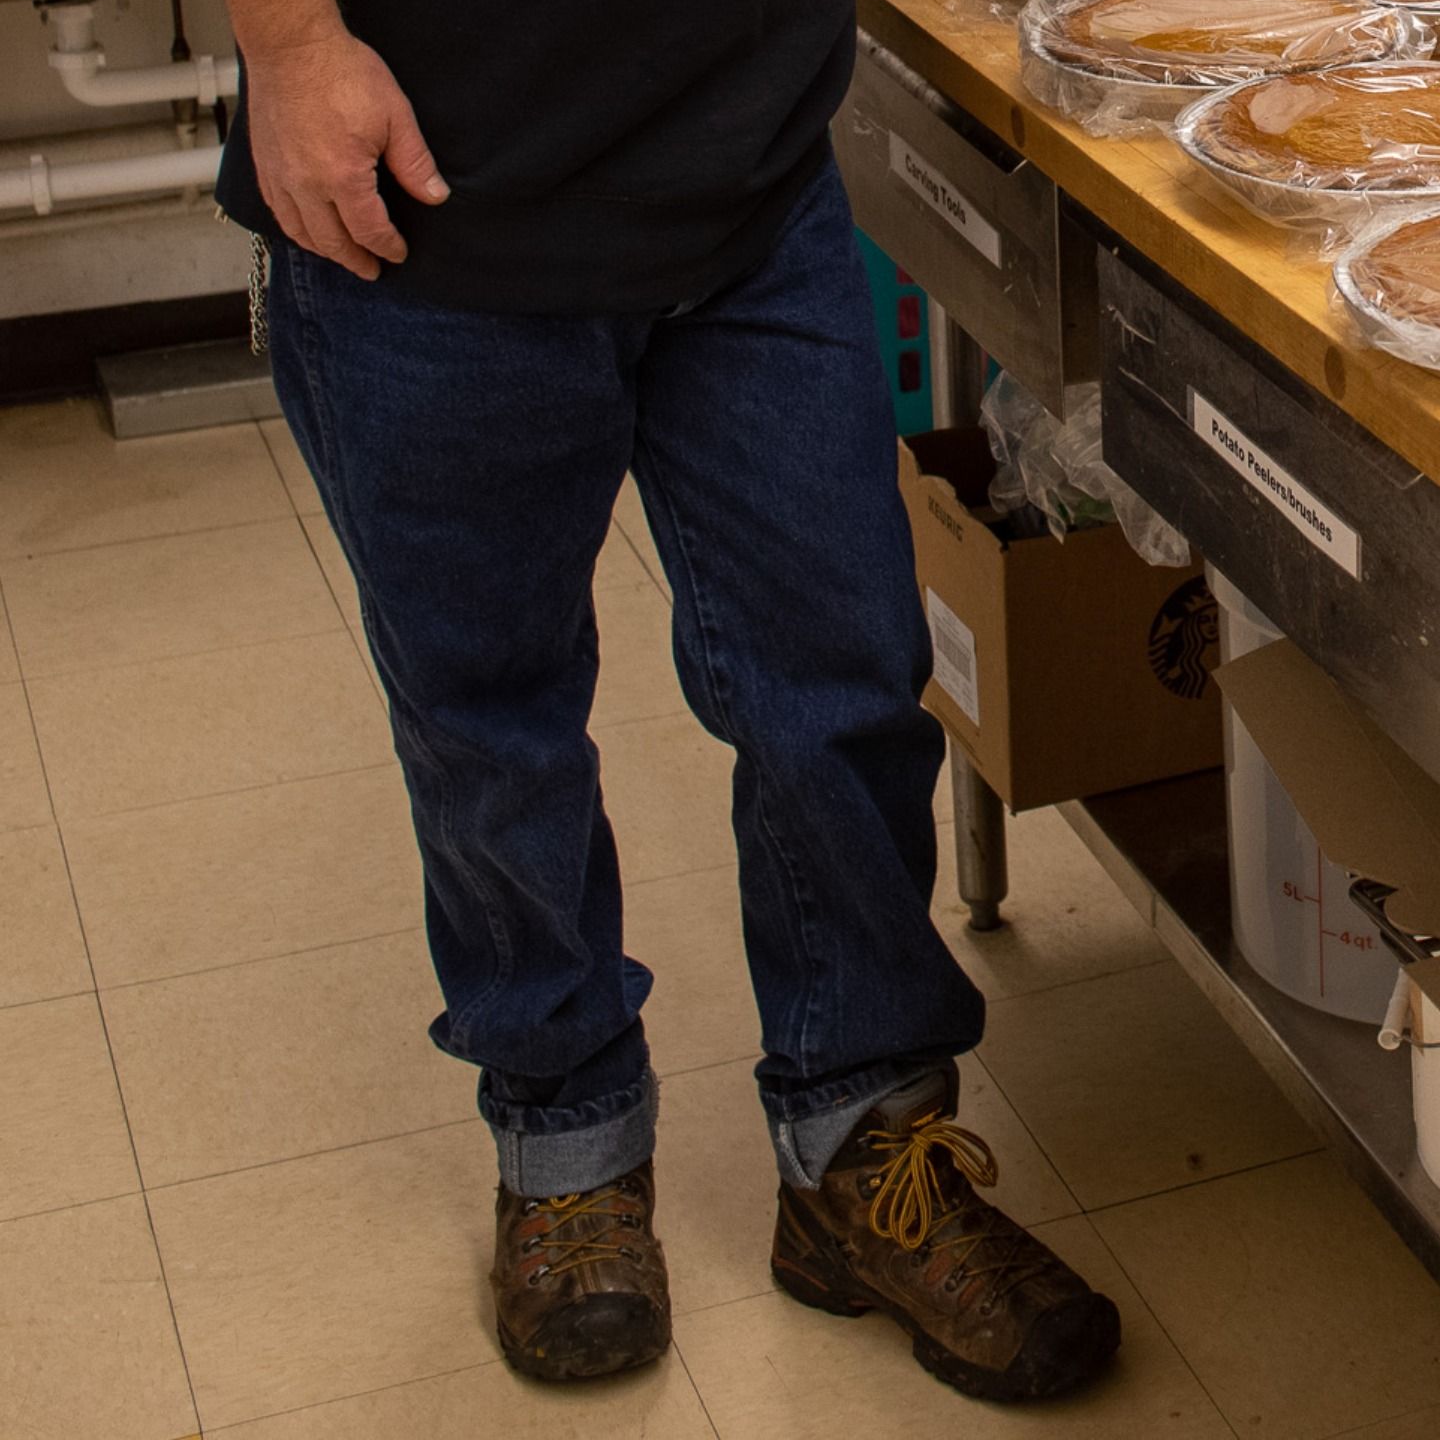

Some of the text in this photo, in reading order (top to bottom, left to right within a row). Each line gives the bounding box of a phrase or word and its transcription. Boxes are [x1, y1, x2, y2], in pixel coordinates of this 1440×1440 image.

[1211, 417, 1334, 543] Potato Peelers/brushes
[928, 495, 964, 544] KEURIG
[1283, 880, 1304, 903] 5L
